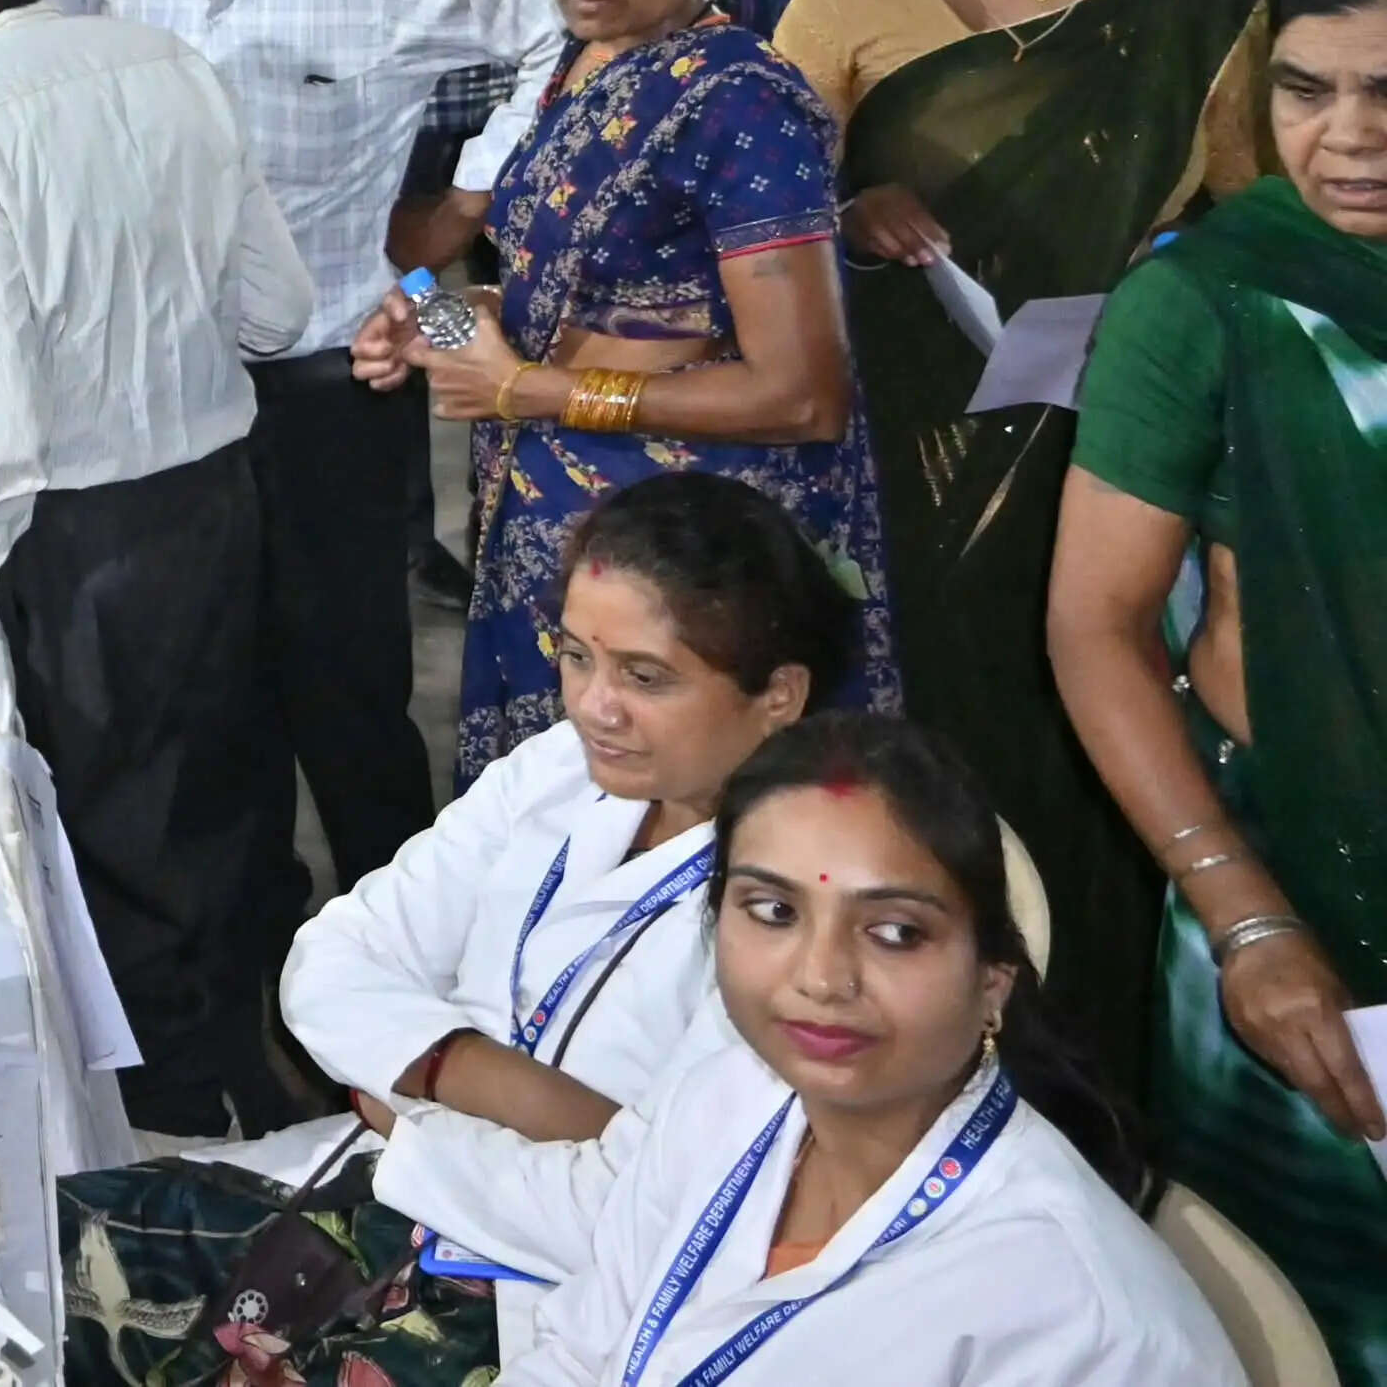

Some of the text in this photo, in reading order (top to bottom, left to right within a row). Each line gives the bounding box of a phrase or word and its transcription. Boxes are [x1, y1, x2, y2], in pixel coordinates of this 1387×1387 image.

[544, 968, 571, 1008] HEALTH
[959, 1108, 997, 1151] HEALTH
[627, 1321, 654, 1376] HEALTH
[651, 1275, 683, 1320] FAMILY
[674, 1222, 715, 1280] WELFARE
[703, 1346, 737, 1383] FAMILY
[733, 1310, 783, 1354] WELFARE
